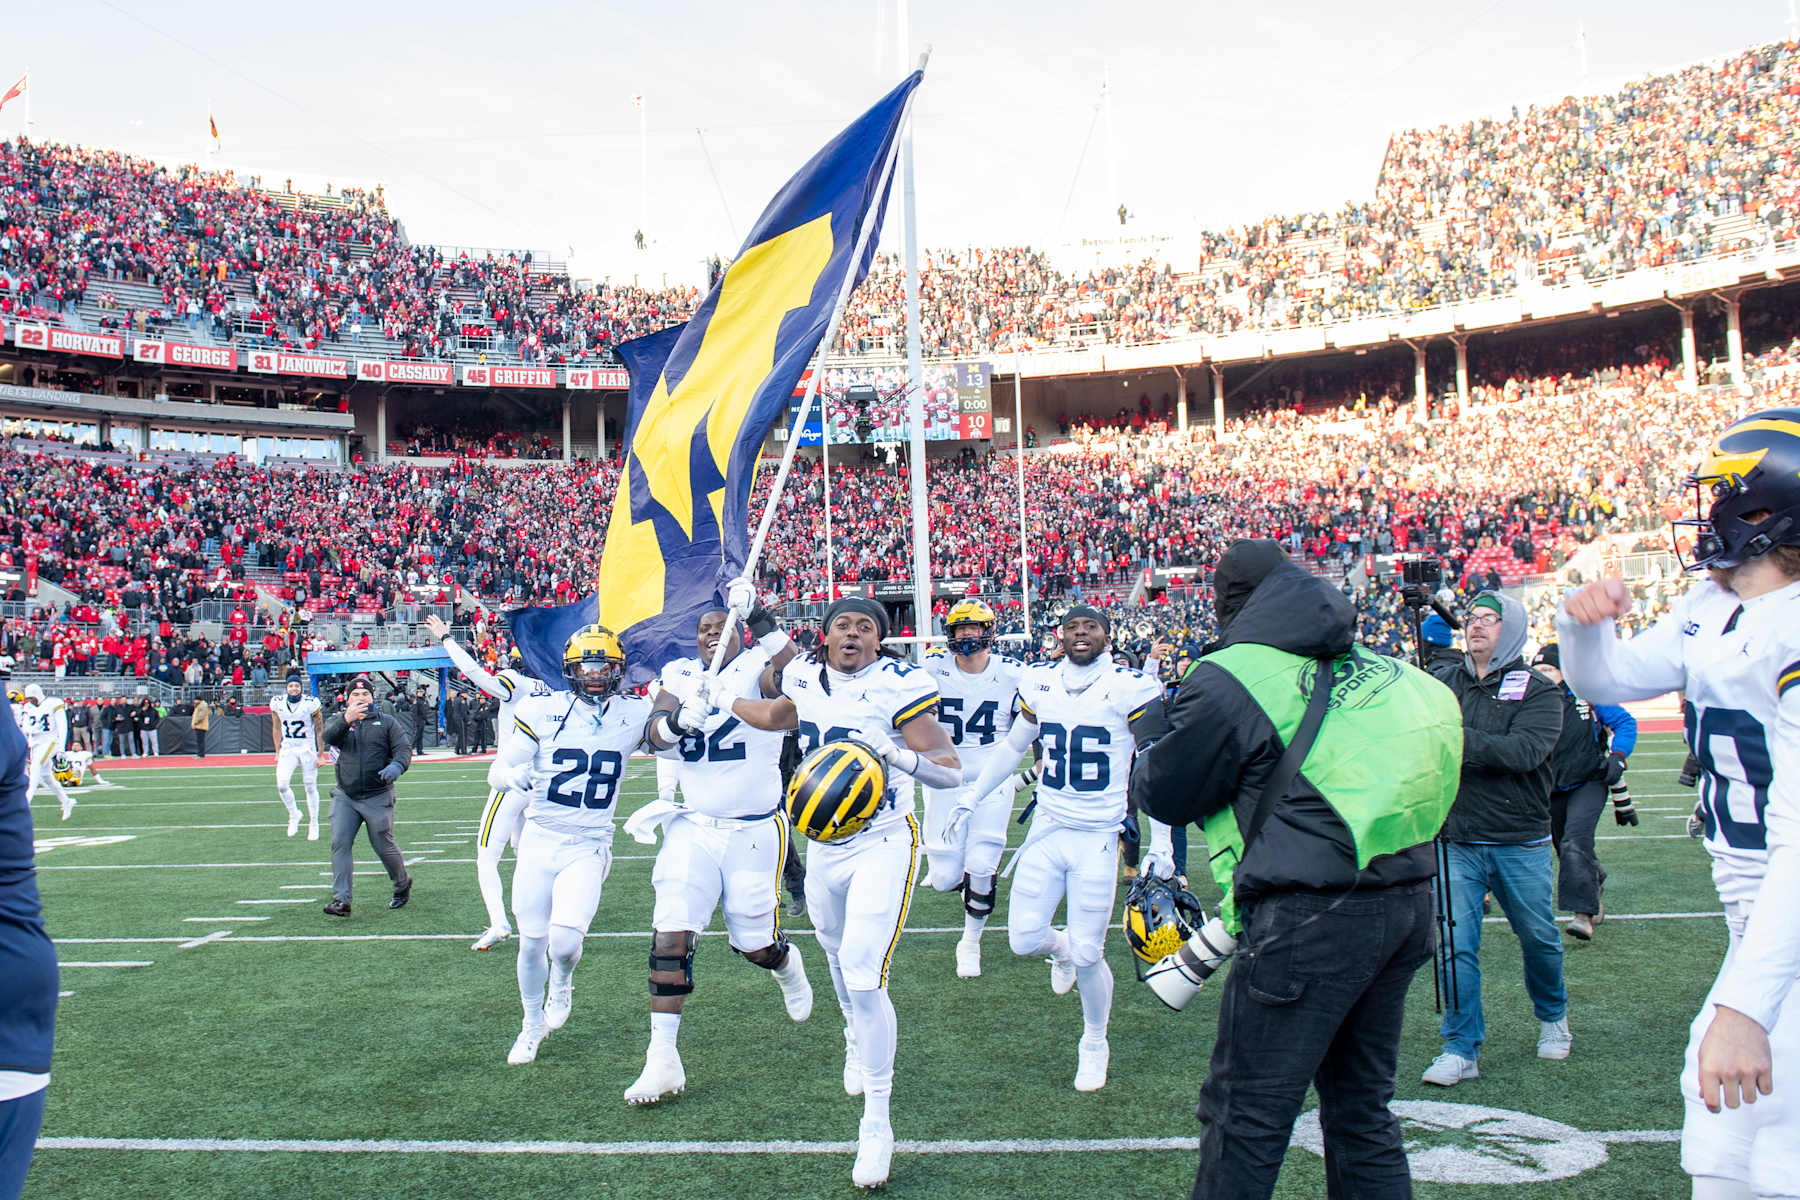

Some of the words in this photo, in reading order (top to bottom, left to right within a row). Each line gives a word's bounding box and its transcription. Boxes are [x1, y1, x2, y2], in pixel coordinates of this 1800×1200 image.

[21, 329, 44, 346] 22
[51, 331, 121, 356] HORVATH
[140, 343, 161, 359] 27
[172, 346, 231, 367] GEORGE
[254, 355, 273, 370] 31
[278, 356, 347, 375] JANOWICZ
[361, 363, 382, 378] 40
[389, 364, 449, 381] CASSADY
[467, 369, 487, 384] 45
[494, 370, 552, 386] GRIFFIN
[570, 372, 590, 387] 47
[598, 372, 630, 387] HAR
[966, 374, 983, 387] 13
[964, 400, 987, 410] 0:00
[967, 415, 985, 428] 10
[1328, 664, 1390, 711] SPORTS
[281, 721, 307, 739] 12
[939, 697, 999, 746] 54
[1039, 722, 1111, 792] 36
[547, 748, 622, 810] 28
